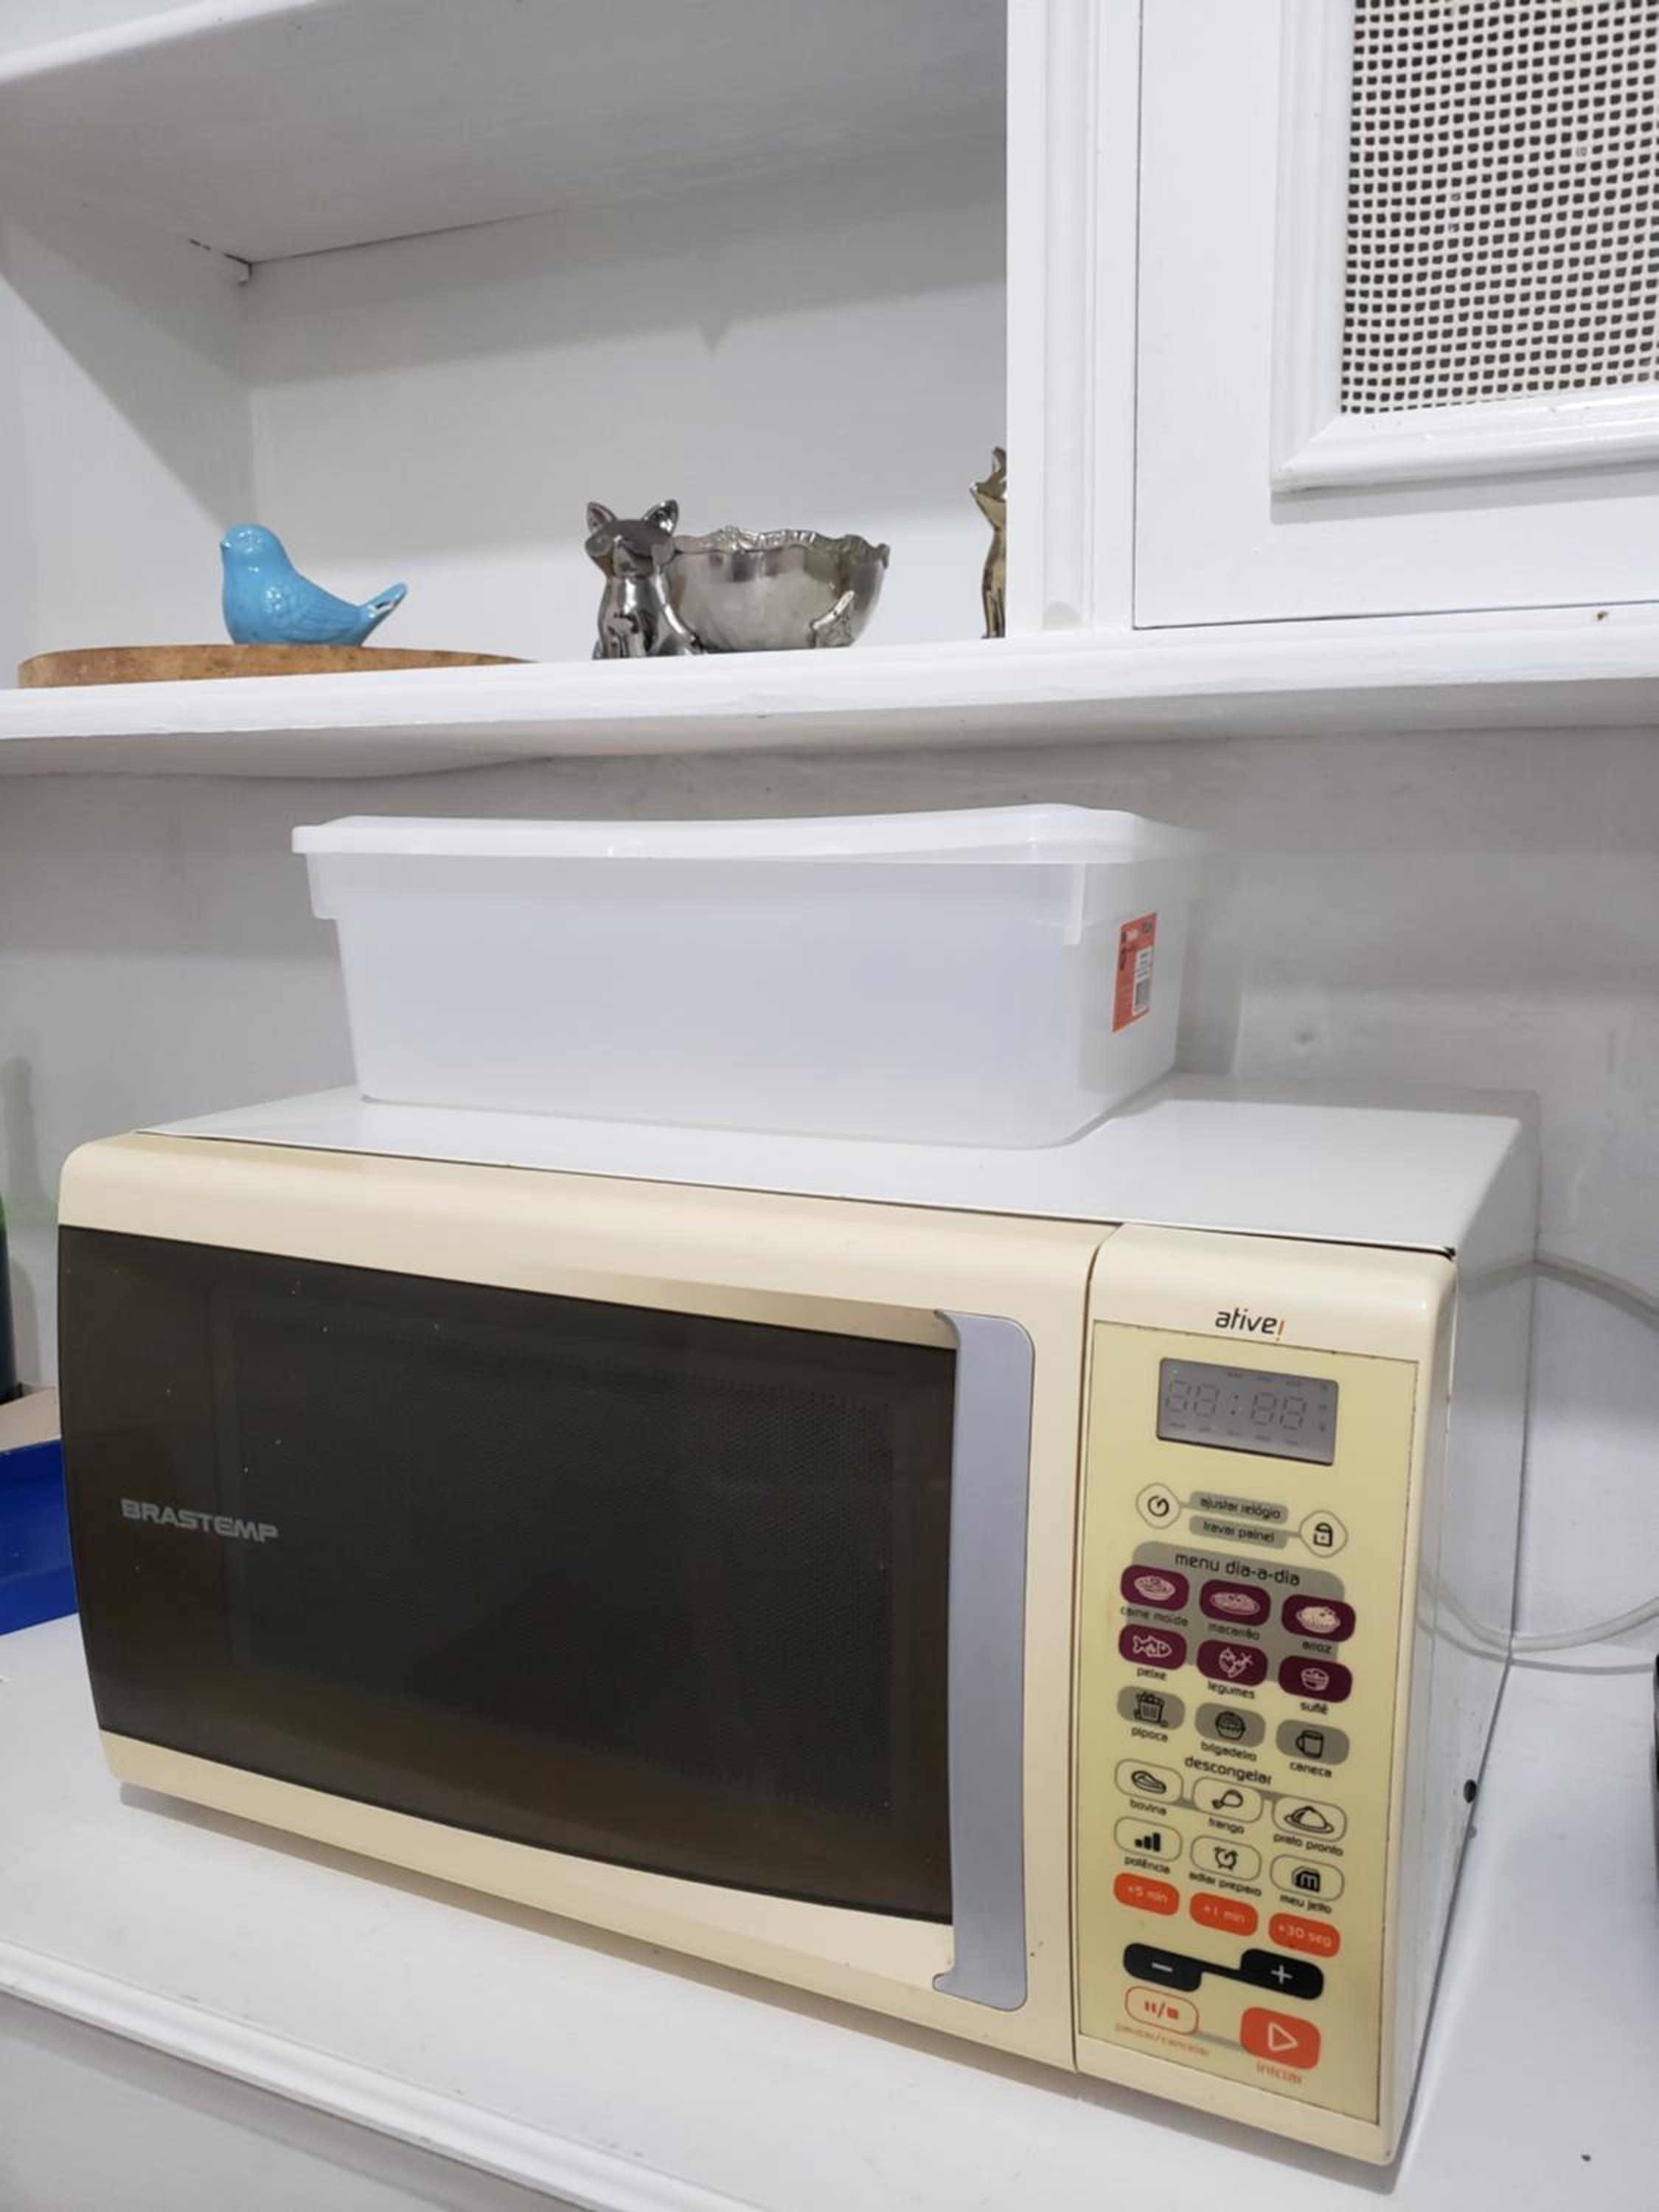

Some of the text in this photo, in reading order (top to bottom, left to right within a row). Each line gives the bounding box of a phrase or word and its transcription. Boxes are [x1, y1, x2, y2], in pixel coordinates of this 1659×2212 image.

[1214, 1307, 1285, 1342] ative!
[1200, 1497, 1281, 1520] ajustar relógio
[120, 1498, 279, 1543] BRASTEMP
[1203, 1521, 1275, 1543] travar painel
[1175, 1553, 1301, 1586] menu dia-a-dia
[1302, 1641, 1332, 1655] arroz
[1136, 1666, 1166, 1682] peixe
[1208, 1680, 1256, 1700] legumes
[1130, 1725, 1169, 1743] pipoca
[1200, 1741, 1257, 1761] brigadeiro
[1185, 1756, 1273, 1785] descongelar
[1290, 1760, 1332, 1778] caneca
[1208, 1817, 1245, 1835] frango
[1273, 1832, 1344, 1857] prato pronto
[1189, 1871, 1262, 1897] adiar preparo
[1279, 1893, 1332, 1914] meu jeito
[1222, 1909, 1246, 1924] min
[1256, 2062, 1302, 2084] iniciar
